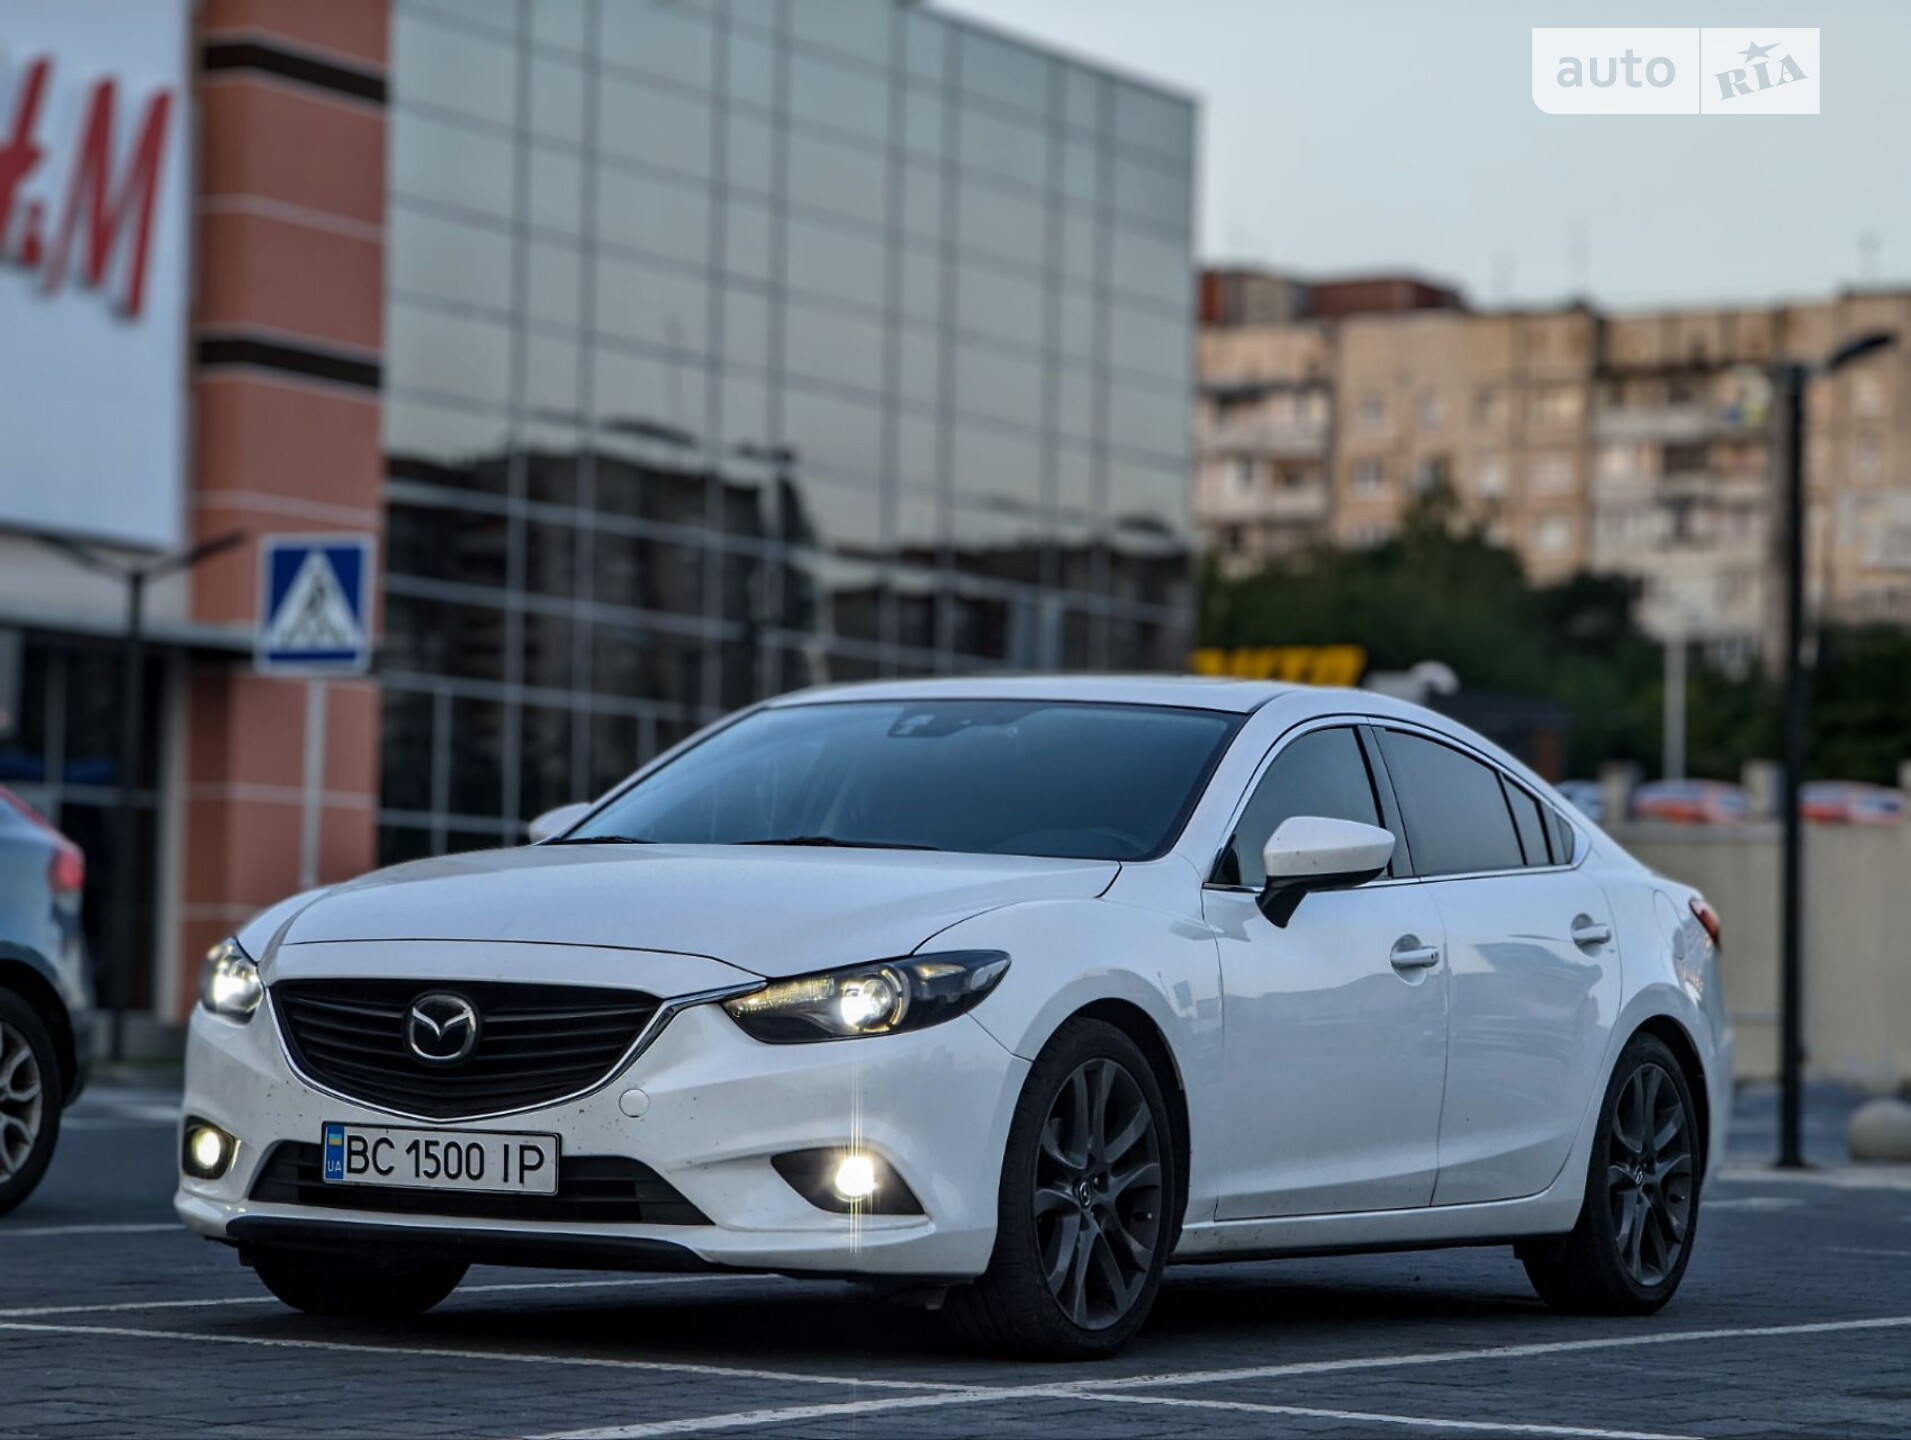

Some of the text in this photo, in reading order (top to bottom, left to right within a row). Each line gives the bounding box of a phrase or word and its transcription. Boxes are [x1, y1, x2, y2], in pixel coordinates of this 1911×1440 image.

[327, 1160, 342, 1173] UA
[347, 1134, 544, 1184] BC 1500 IP
